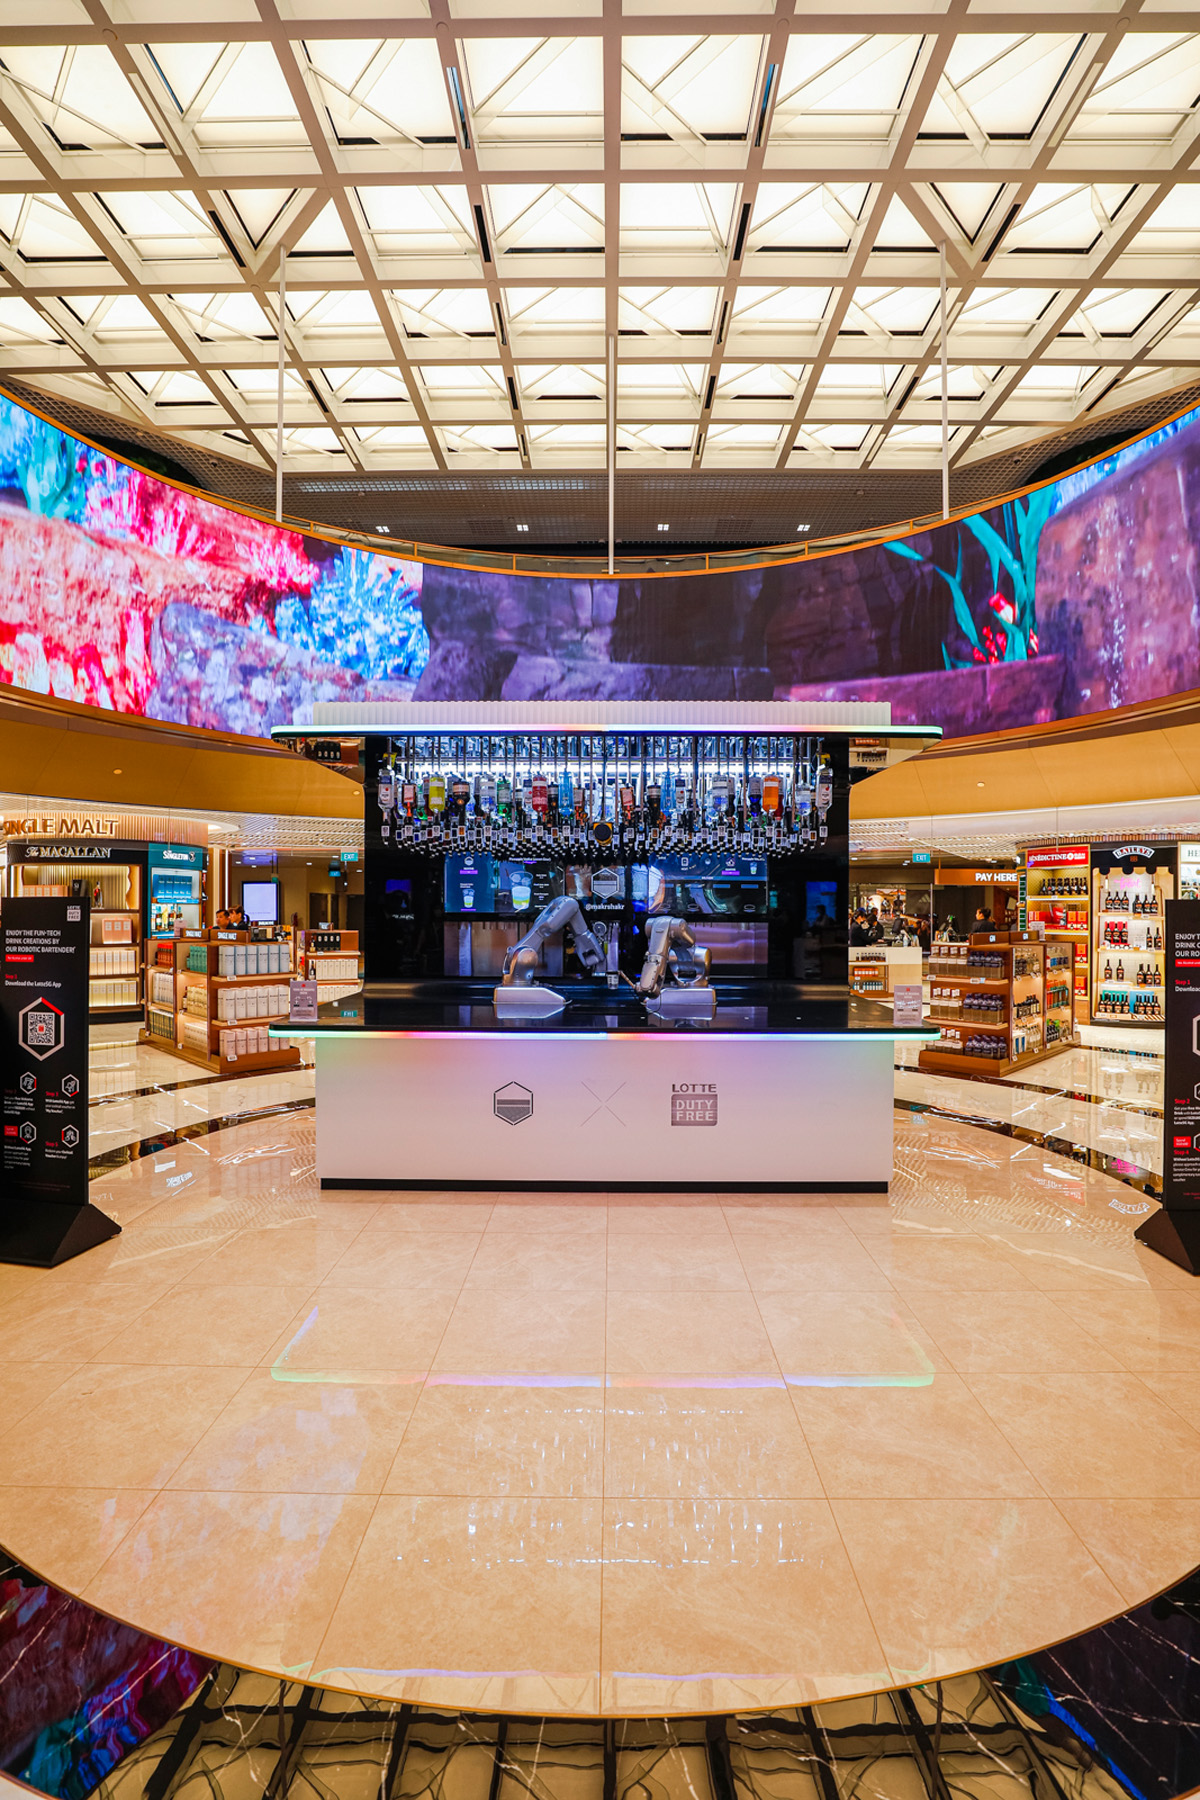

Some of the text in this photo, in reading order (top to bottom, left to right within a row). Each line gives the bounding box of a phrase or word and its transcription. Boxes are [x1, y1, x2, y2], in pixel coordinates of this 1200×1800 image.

[59, 819, 119, 834] MALT
[39, 847, 112, 858] MACALLAN
[975, 873, 1018, 882] PAY HERE
[585, 903, 625, 911] @makrshakr
[23, 938, 52, 946] CREATIONS
[41, 946, 76, 954] BARTENDER!
[671, 1083, 717, 1093] LOTTE
[676, 1099, 714, 1110] DUTY
[676, 1110, 714, 1121] FREE
